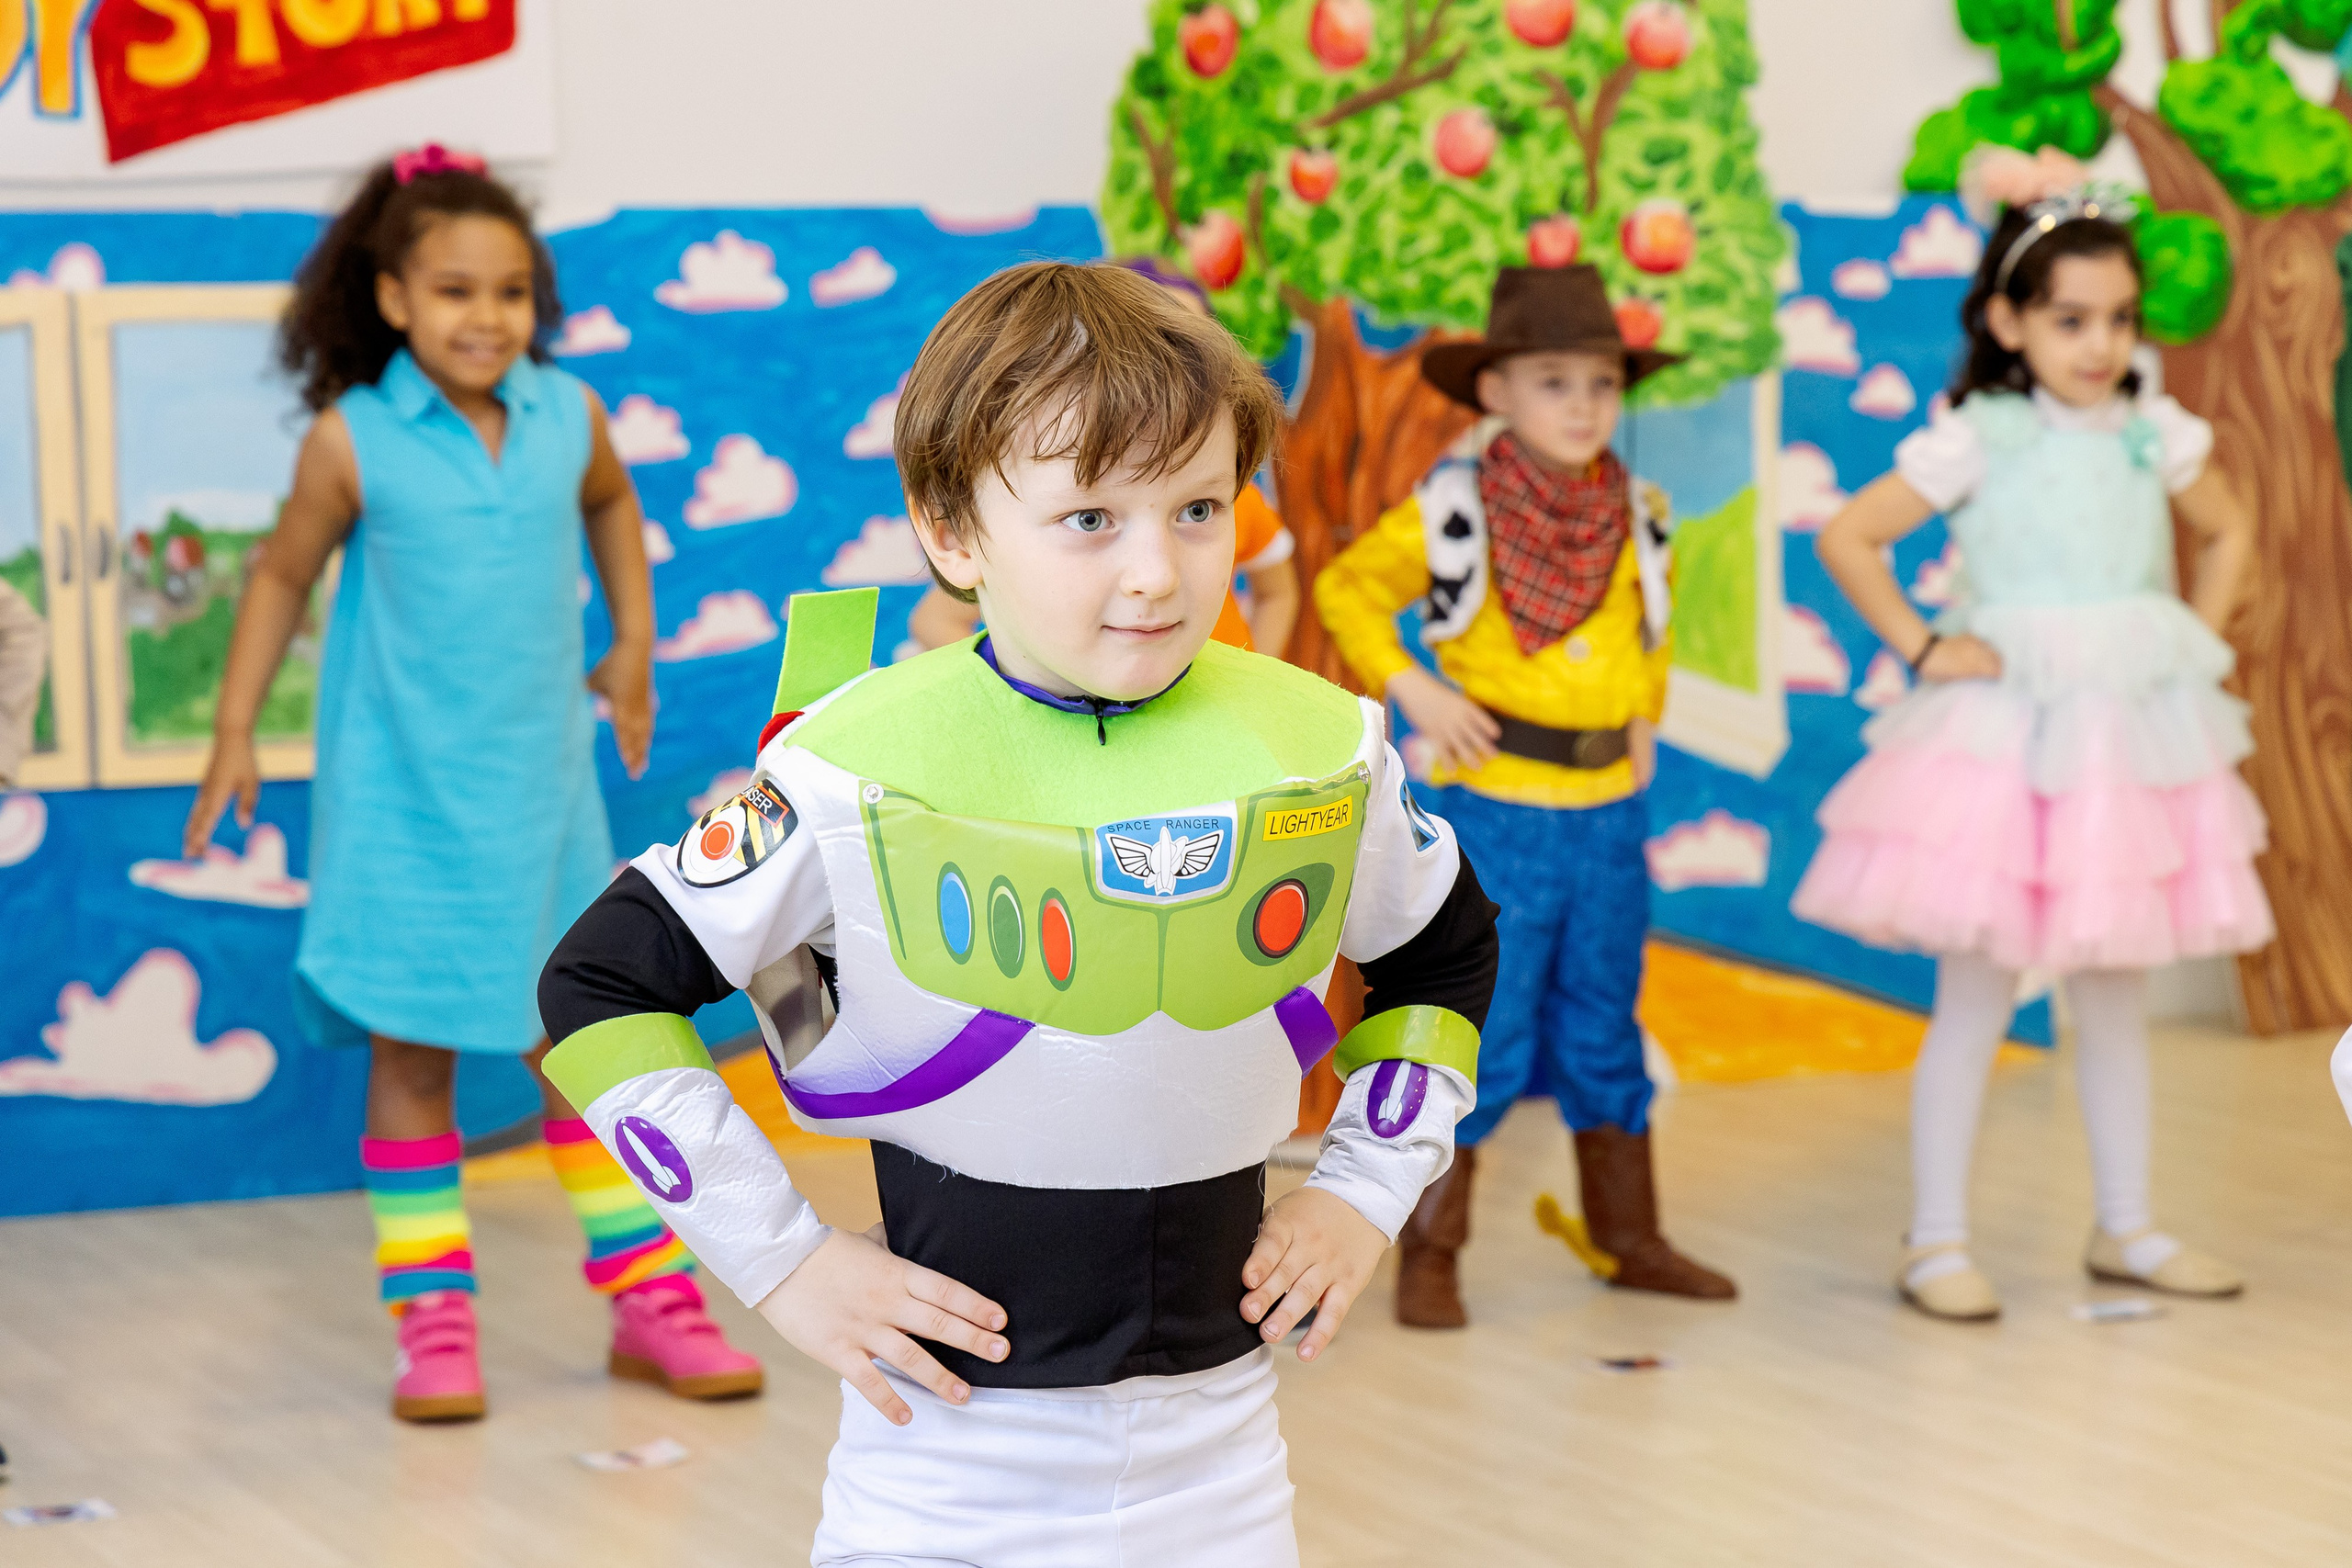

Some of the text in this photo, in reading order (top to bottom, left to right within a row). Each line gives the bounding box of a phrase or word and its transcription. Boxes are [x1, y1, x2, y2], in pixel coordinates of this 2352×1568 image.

[1107, 818, 1220, 833] SPACE RANGER
[1269, 803, 1350, 835] LIGHTYEAR
